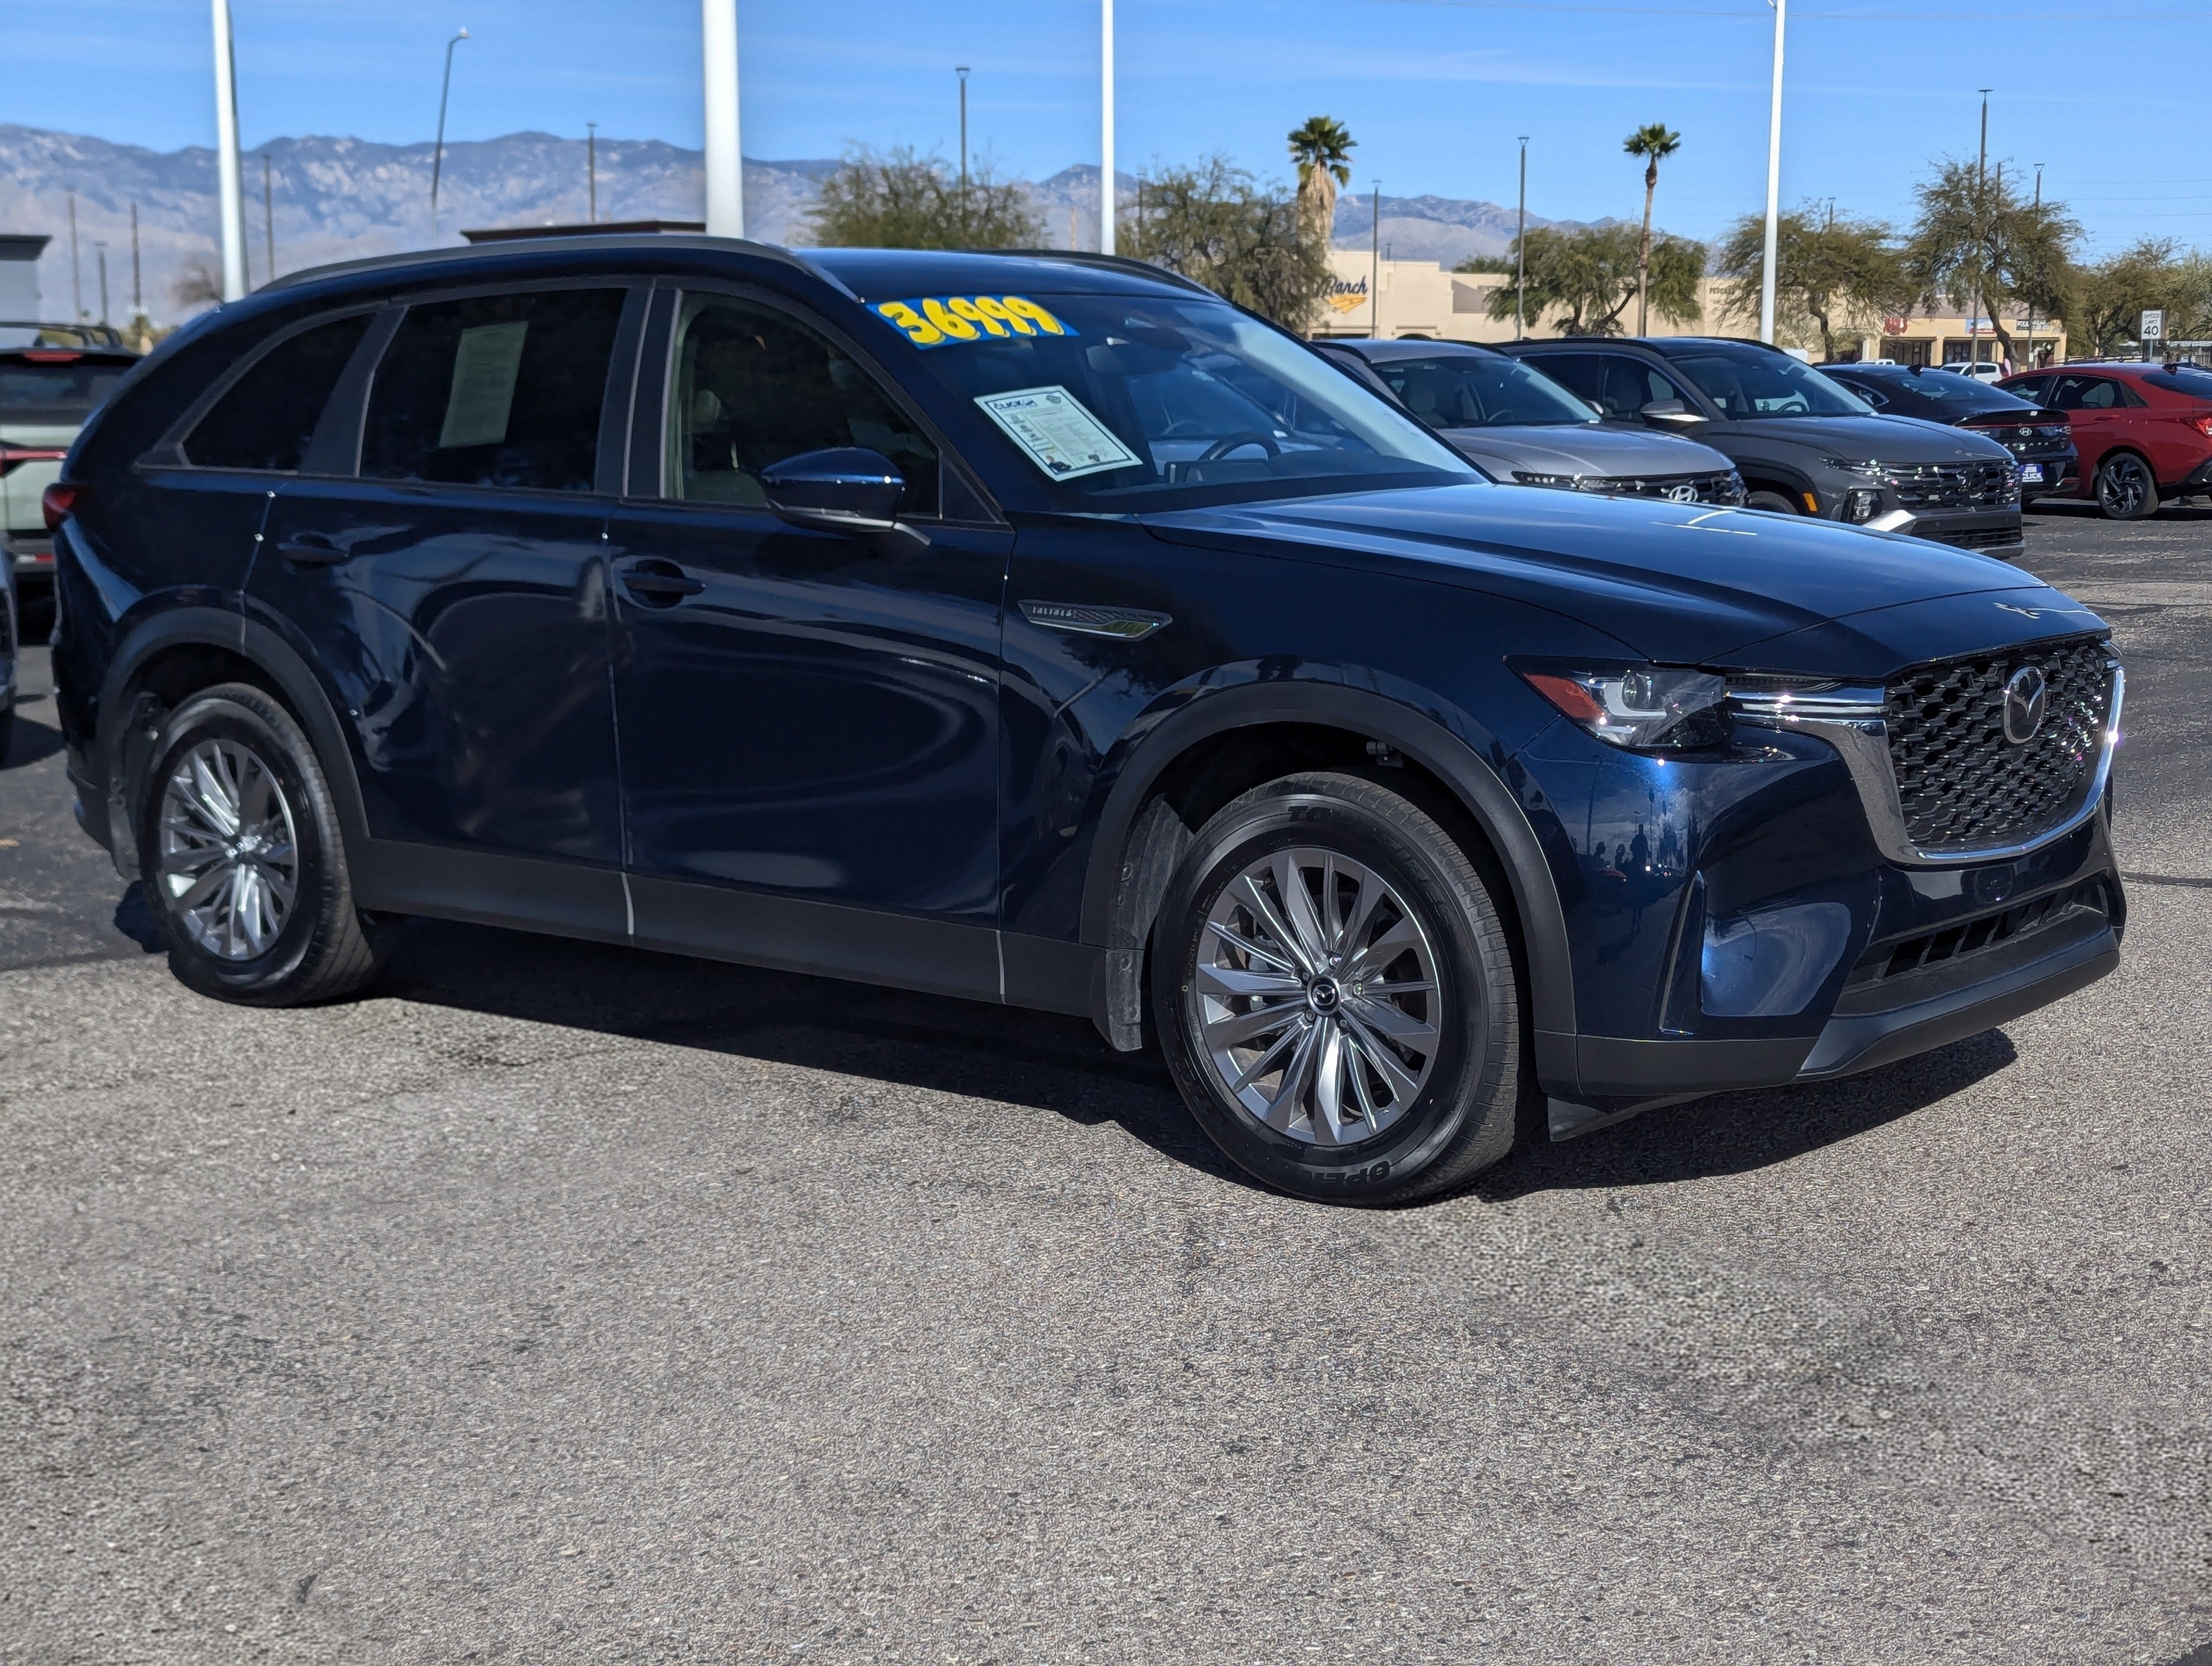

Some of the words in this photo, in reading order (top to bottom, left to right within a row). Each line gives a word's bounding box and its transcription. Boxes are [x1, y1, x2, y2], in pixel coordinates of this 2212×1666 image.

[1323, 274, 1368, 297] Ranch
[878, 296, 1065, 345] 36999
[2144, 325, 2159, 336] 40
